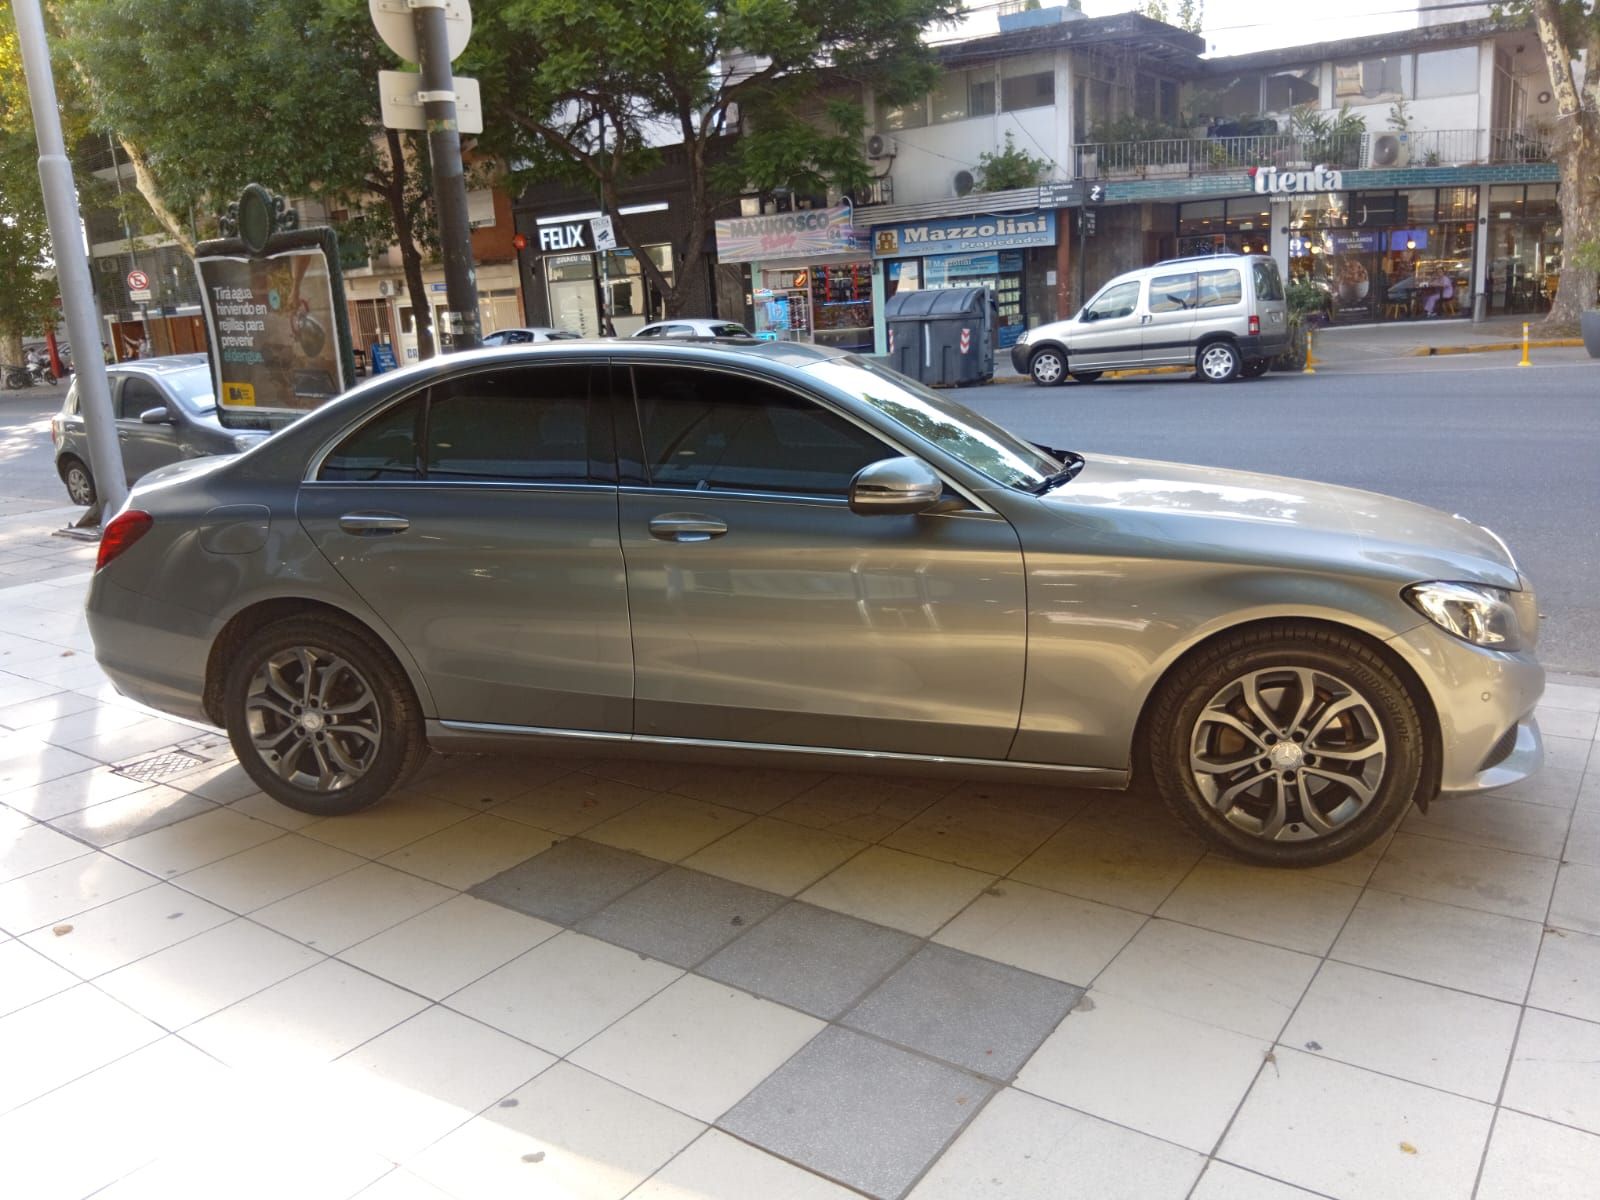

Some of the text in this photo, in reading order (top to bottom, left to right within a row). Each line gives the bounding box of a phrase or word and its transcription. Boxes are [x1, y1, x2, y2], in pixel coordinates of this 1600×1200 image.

[904, 215, 1048, 243] Mazzolini
[540, 225, 586, 250] FELIX
[960, 236, 1049, 250] Propiedades
[212, 286, 231, 300] Tirá
[216, 302, 267, 315] hirviendo en
[219, 317, 265, 334] rejillas para
[221, 333, 254, 348] prevenir
